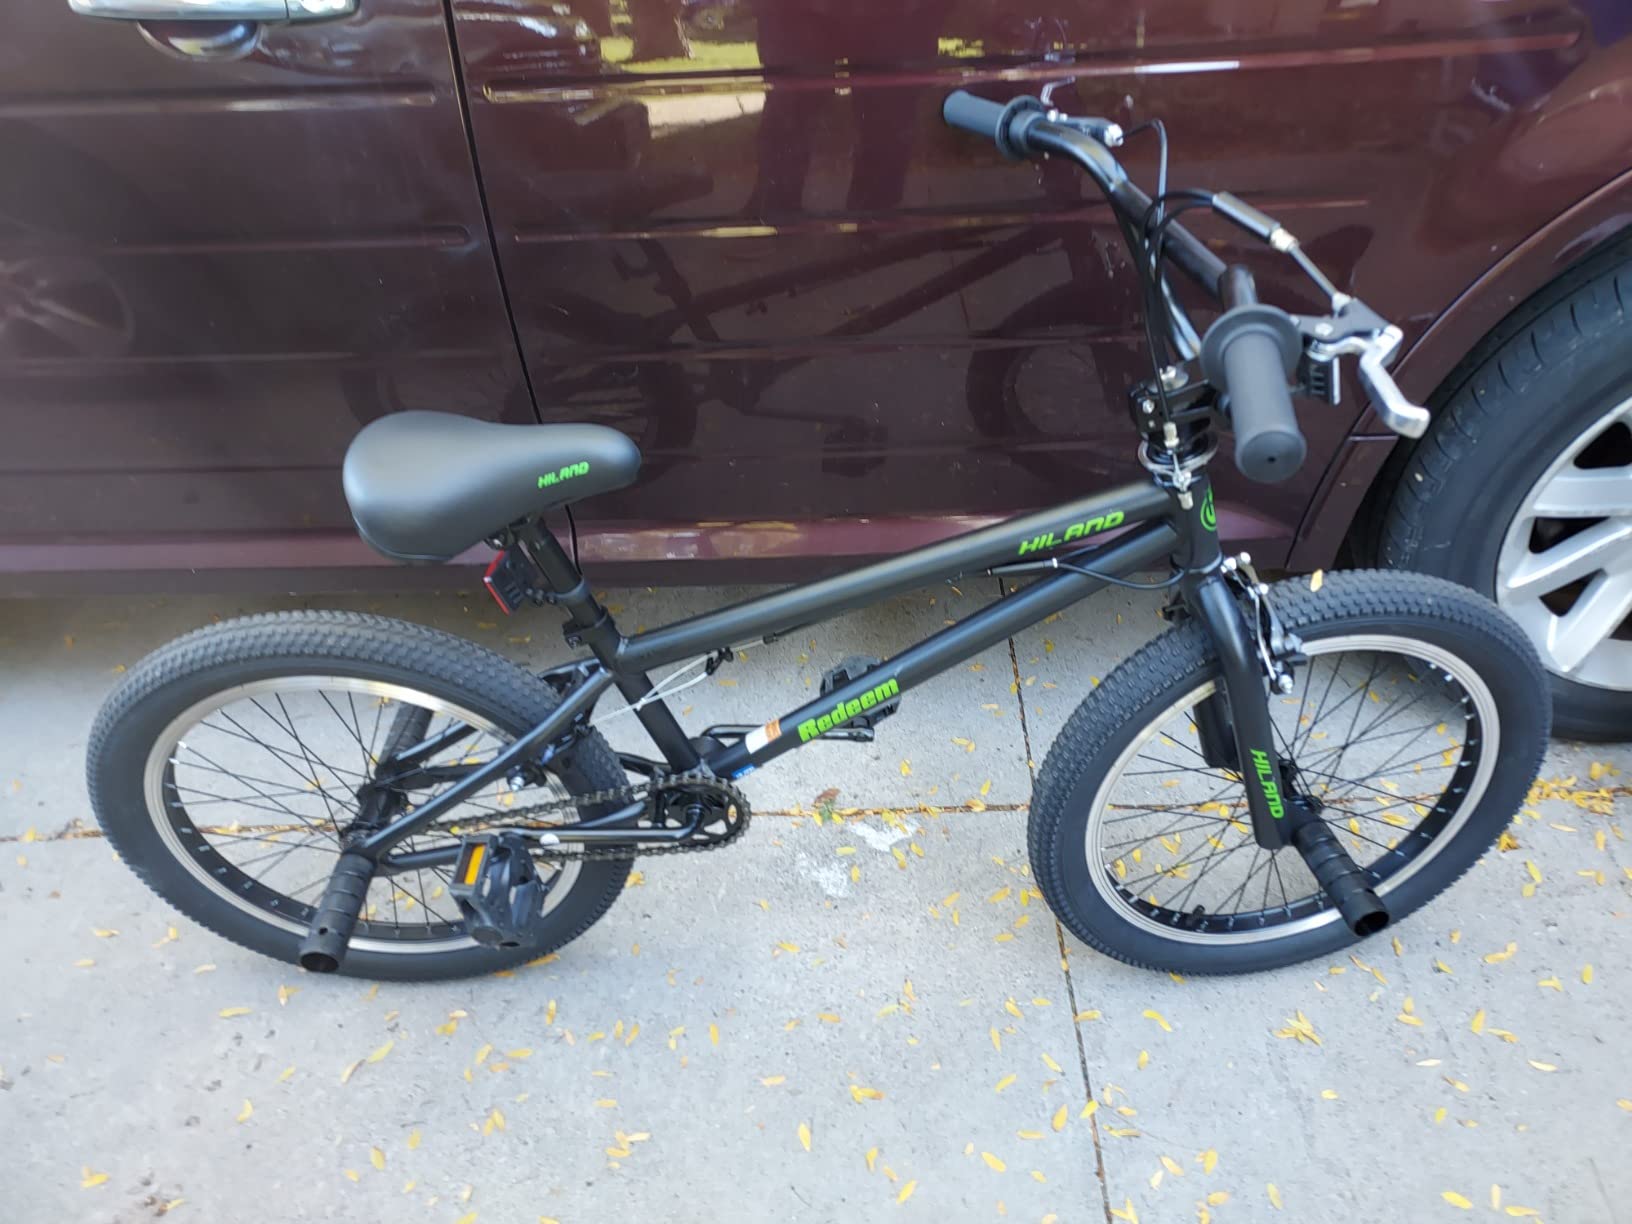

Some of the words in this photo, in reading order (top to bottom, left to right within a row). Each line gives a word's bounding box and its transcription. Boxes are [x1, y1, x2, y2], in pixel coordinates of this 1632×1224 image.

[538, 461, 589, 489] HILAND
[1018, 511, 1125, 556] HILAND
[797, 678, 900, 742] Redeem
[1250, 748, 1285, 819] HILAND
